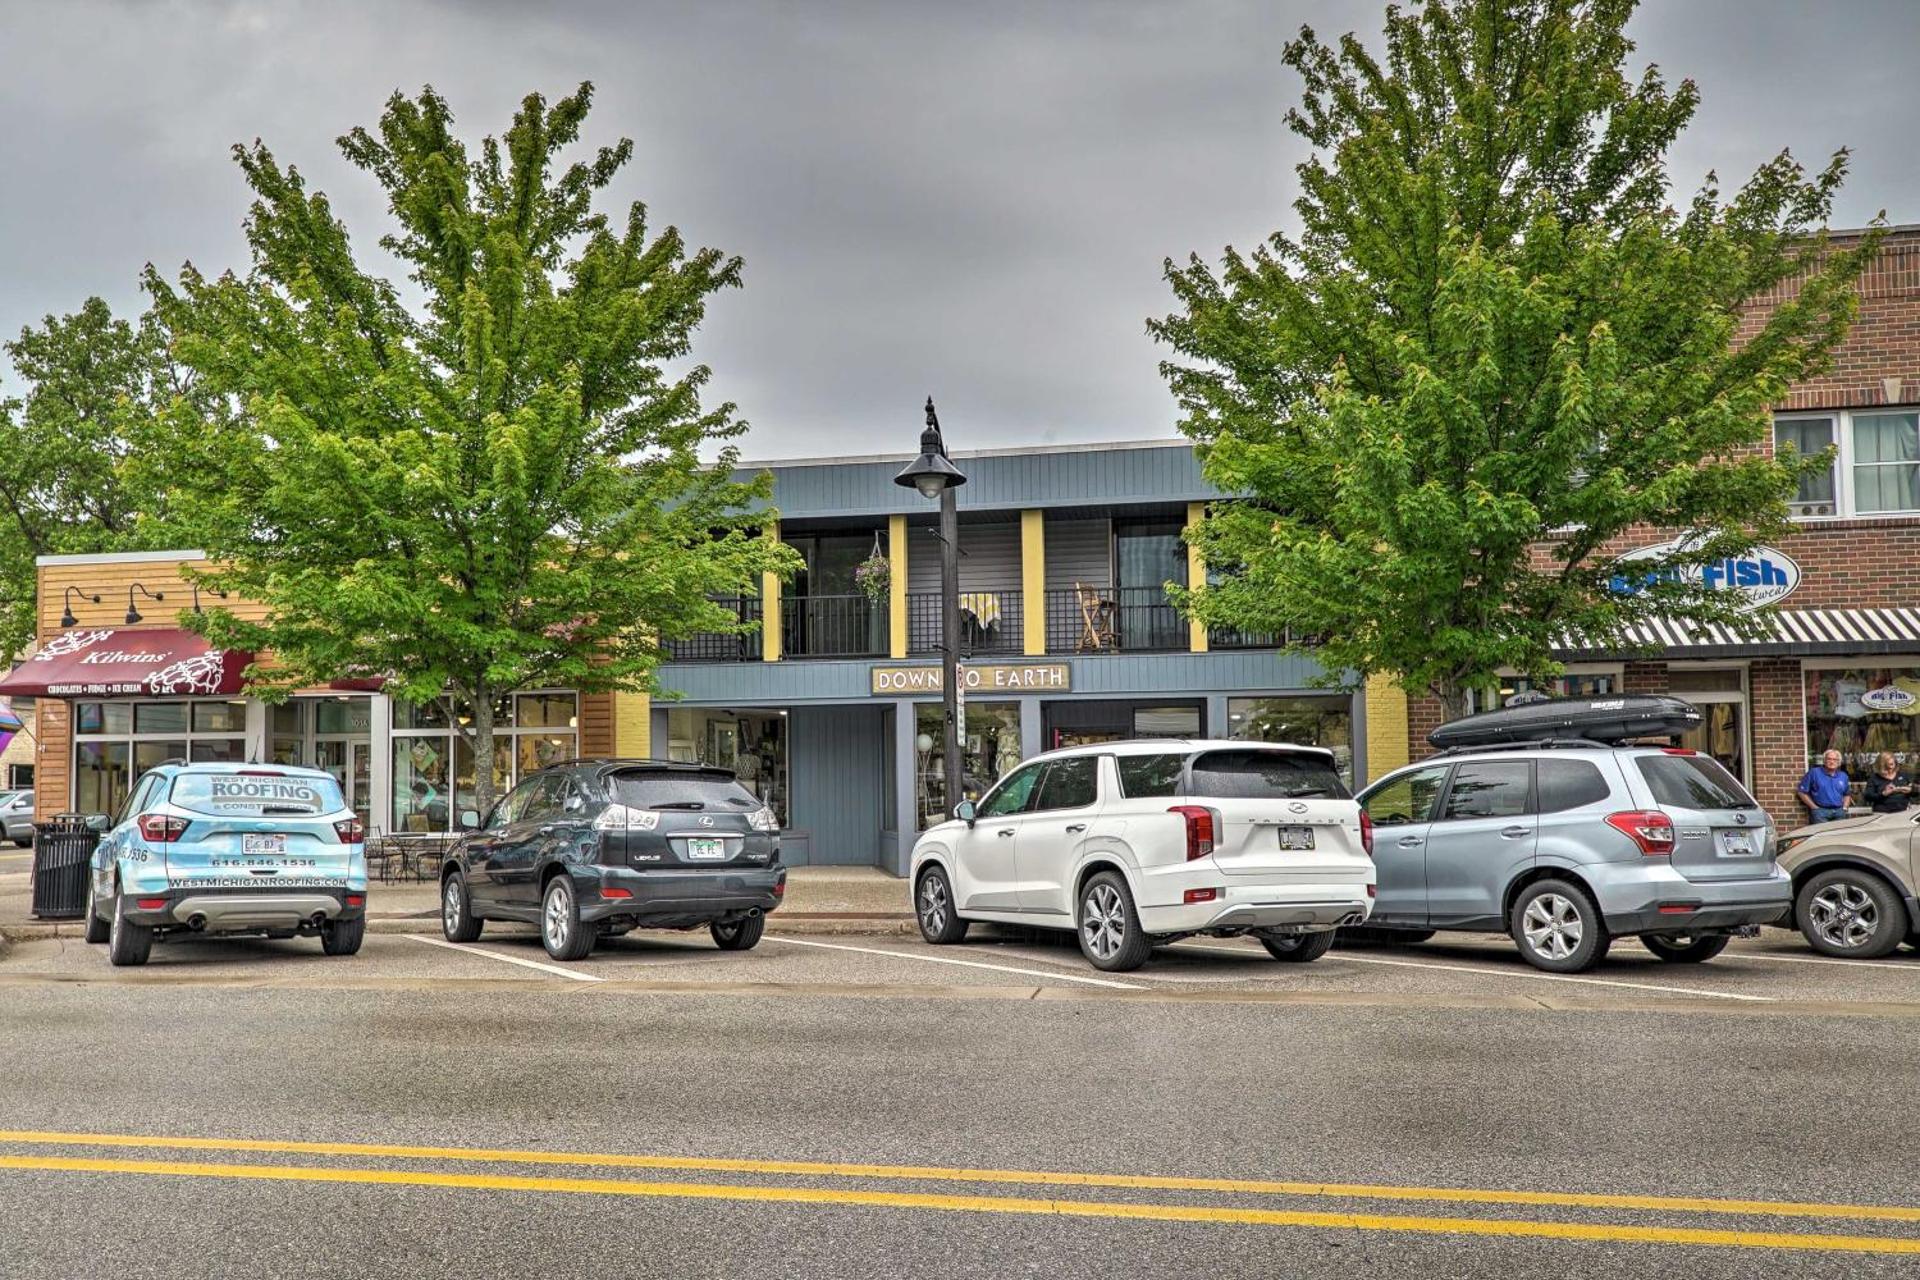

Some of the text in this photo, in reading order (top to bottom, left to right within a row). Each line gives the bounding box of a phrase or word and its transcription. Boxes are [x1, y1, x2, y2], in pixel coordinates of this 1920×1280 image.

[880, 671, 939, 689] DOWN
[996, 668, 1063, 687] EARTH
[47, 684, 142, 694] CHOCOLATES FUDGE ICE CREAM
[212, 783, 310, 799] ROOFING
